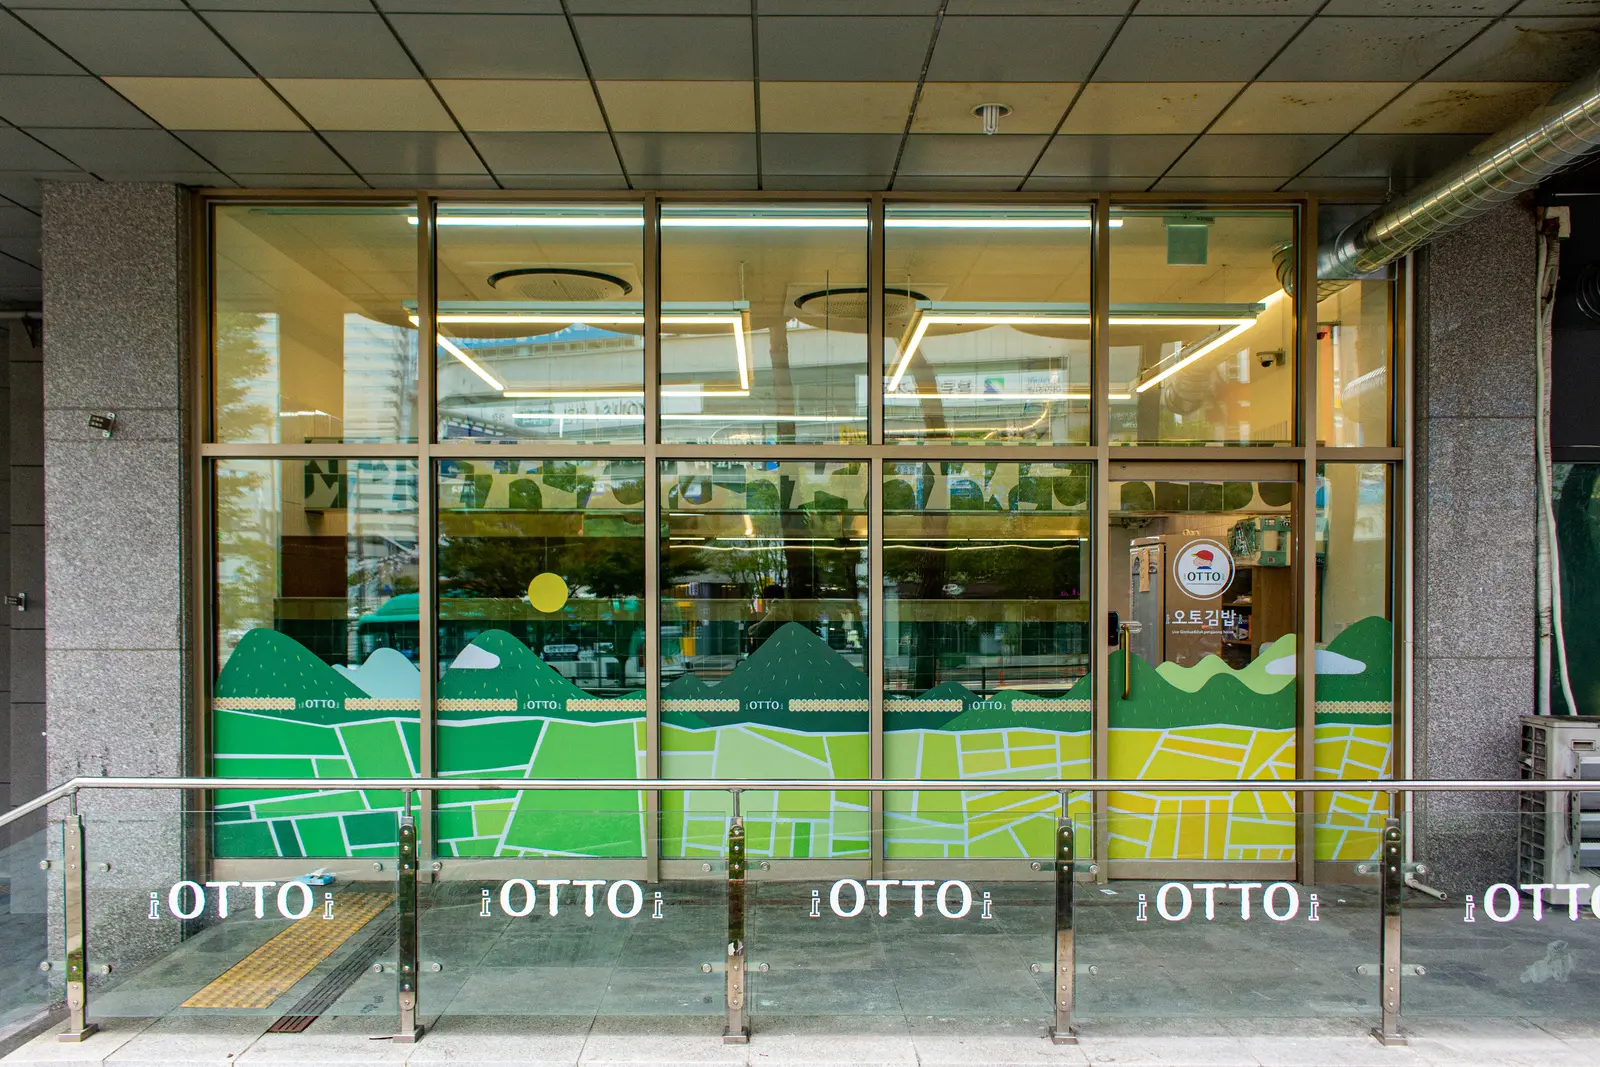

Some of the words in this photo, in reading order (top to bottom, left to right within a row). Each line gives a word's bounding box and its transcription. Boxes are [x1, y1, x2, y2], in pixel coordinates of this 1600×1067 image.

[1187, 571, 1221, 582] OTTO
[1171, 609, 1237, 627] 오토김밥
[305, 699, 336, 709] OTTO
[527, 700, 558, 710] OTTO
[749, 700, 780, 710] OTTO
[972, 700, 1003, 710] OTTO
[169, 880, 314, 919] OTTO
[500, 878, 643, 918] OTTO
[829, 878, 972, 919] OTTO
[1156, 882, 1299, 921] OTTO
[1484, 883, 1600, 922] OTT
